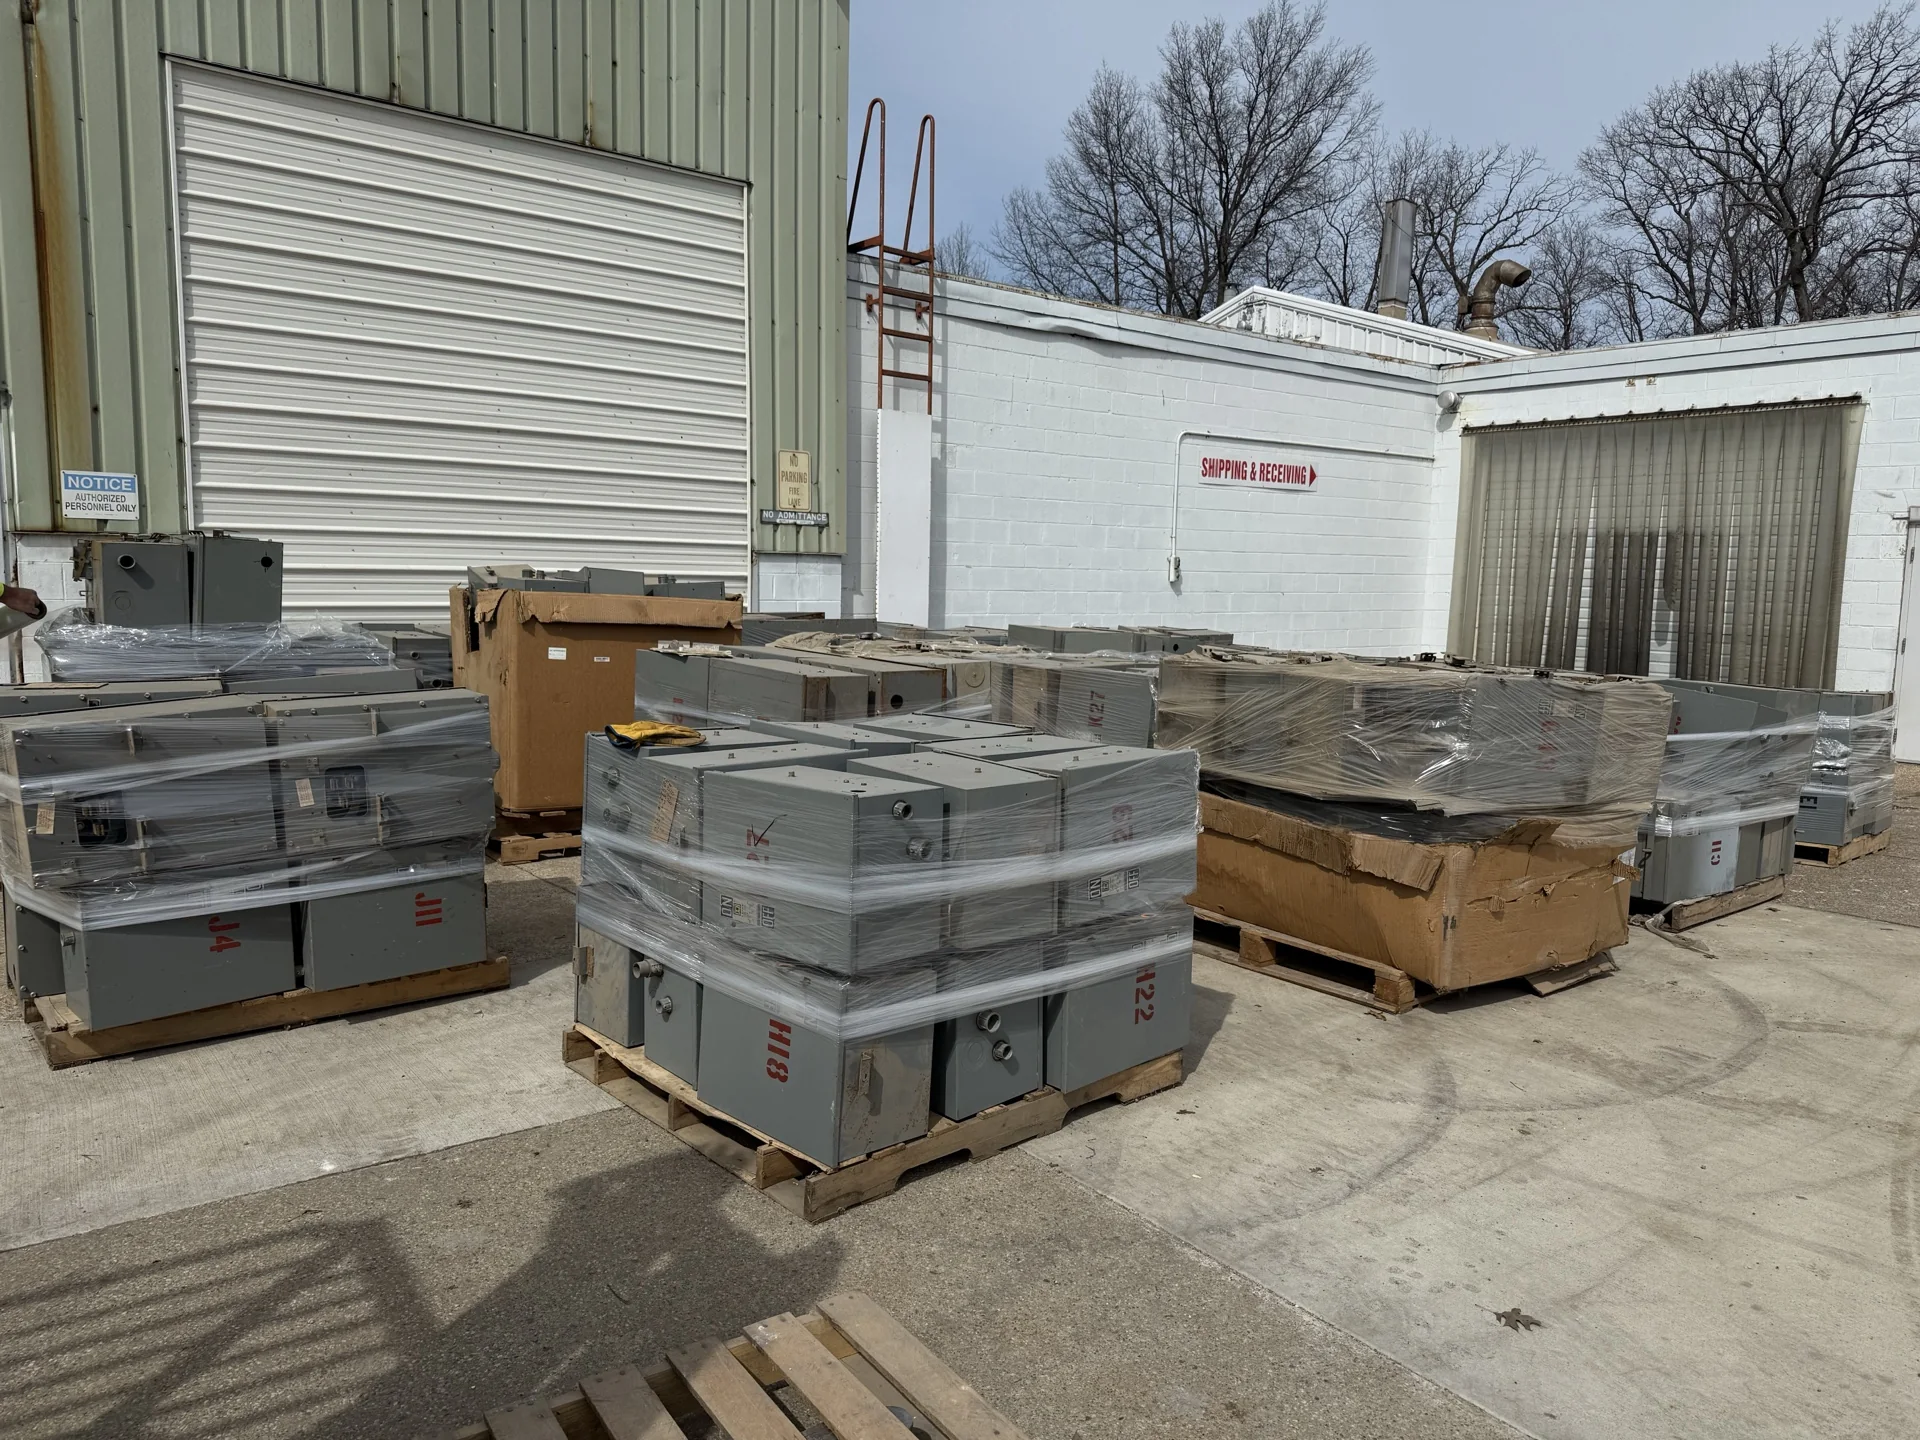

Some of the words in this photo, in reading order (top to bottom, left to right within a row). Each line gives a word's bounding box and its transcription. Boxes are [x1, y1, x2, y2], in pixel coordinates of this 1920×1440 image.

[790, 456, 798, 467] NO
[781, 471, 807, 483] PARKING
[1201, 457, 1247, 480] SHIPPING
[1250, 462, 1257, 480] &
[1259, 462, 1306, 485] RECEIVING
[68, 476, 132, 491] NOTICE
[789, 487, 799, 495] FIRE
[75, 493, 126, 503] AUTHORIZED
[788, 498, 801, 506] LANE
[65, 502, 115, 512] PERSONNEL
[116, 504, 136, 513] ONLY
[763, 510, 774, 518] NO
[778, 513, 827, 521] ADMITTANCE
[1128, 868, 1140, 889] OFF
[1089, 876, 1101, 900] ON
[721, 896, 733, 917] ON
[762, 904, 775, 929] OFF
[208, 916, 242, 953] J4
[766, 1018, 793, 1084] H18
